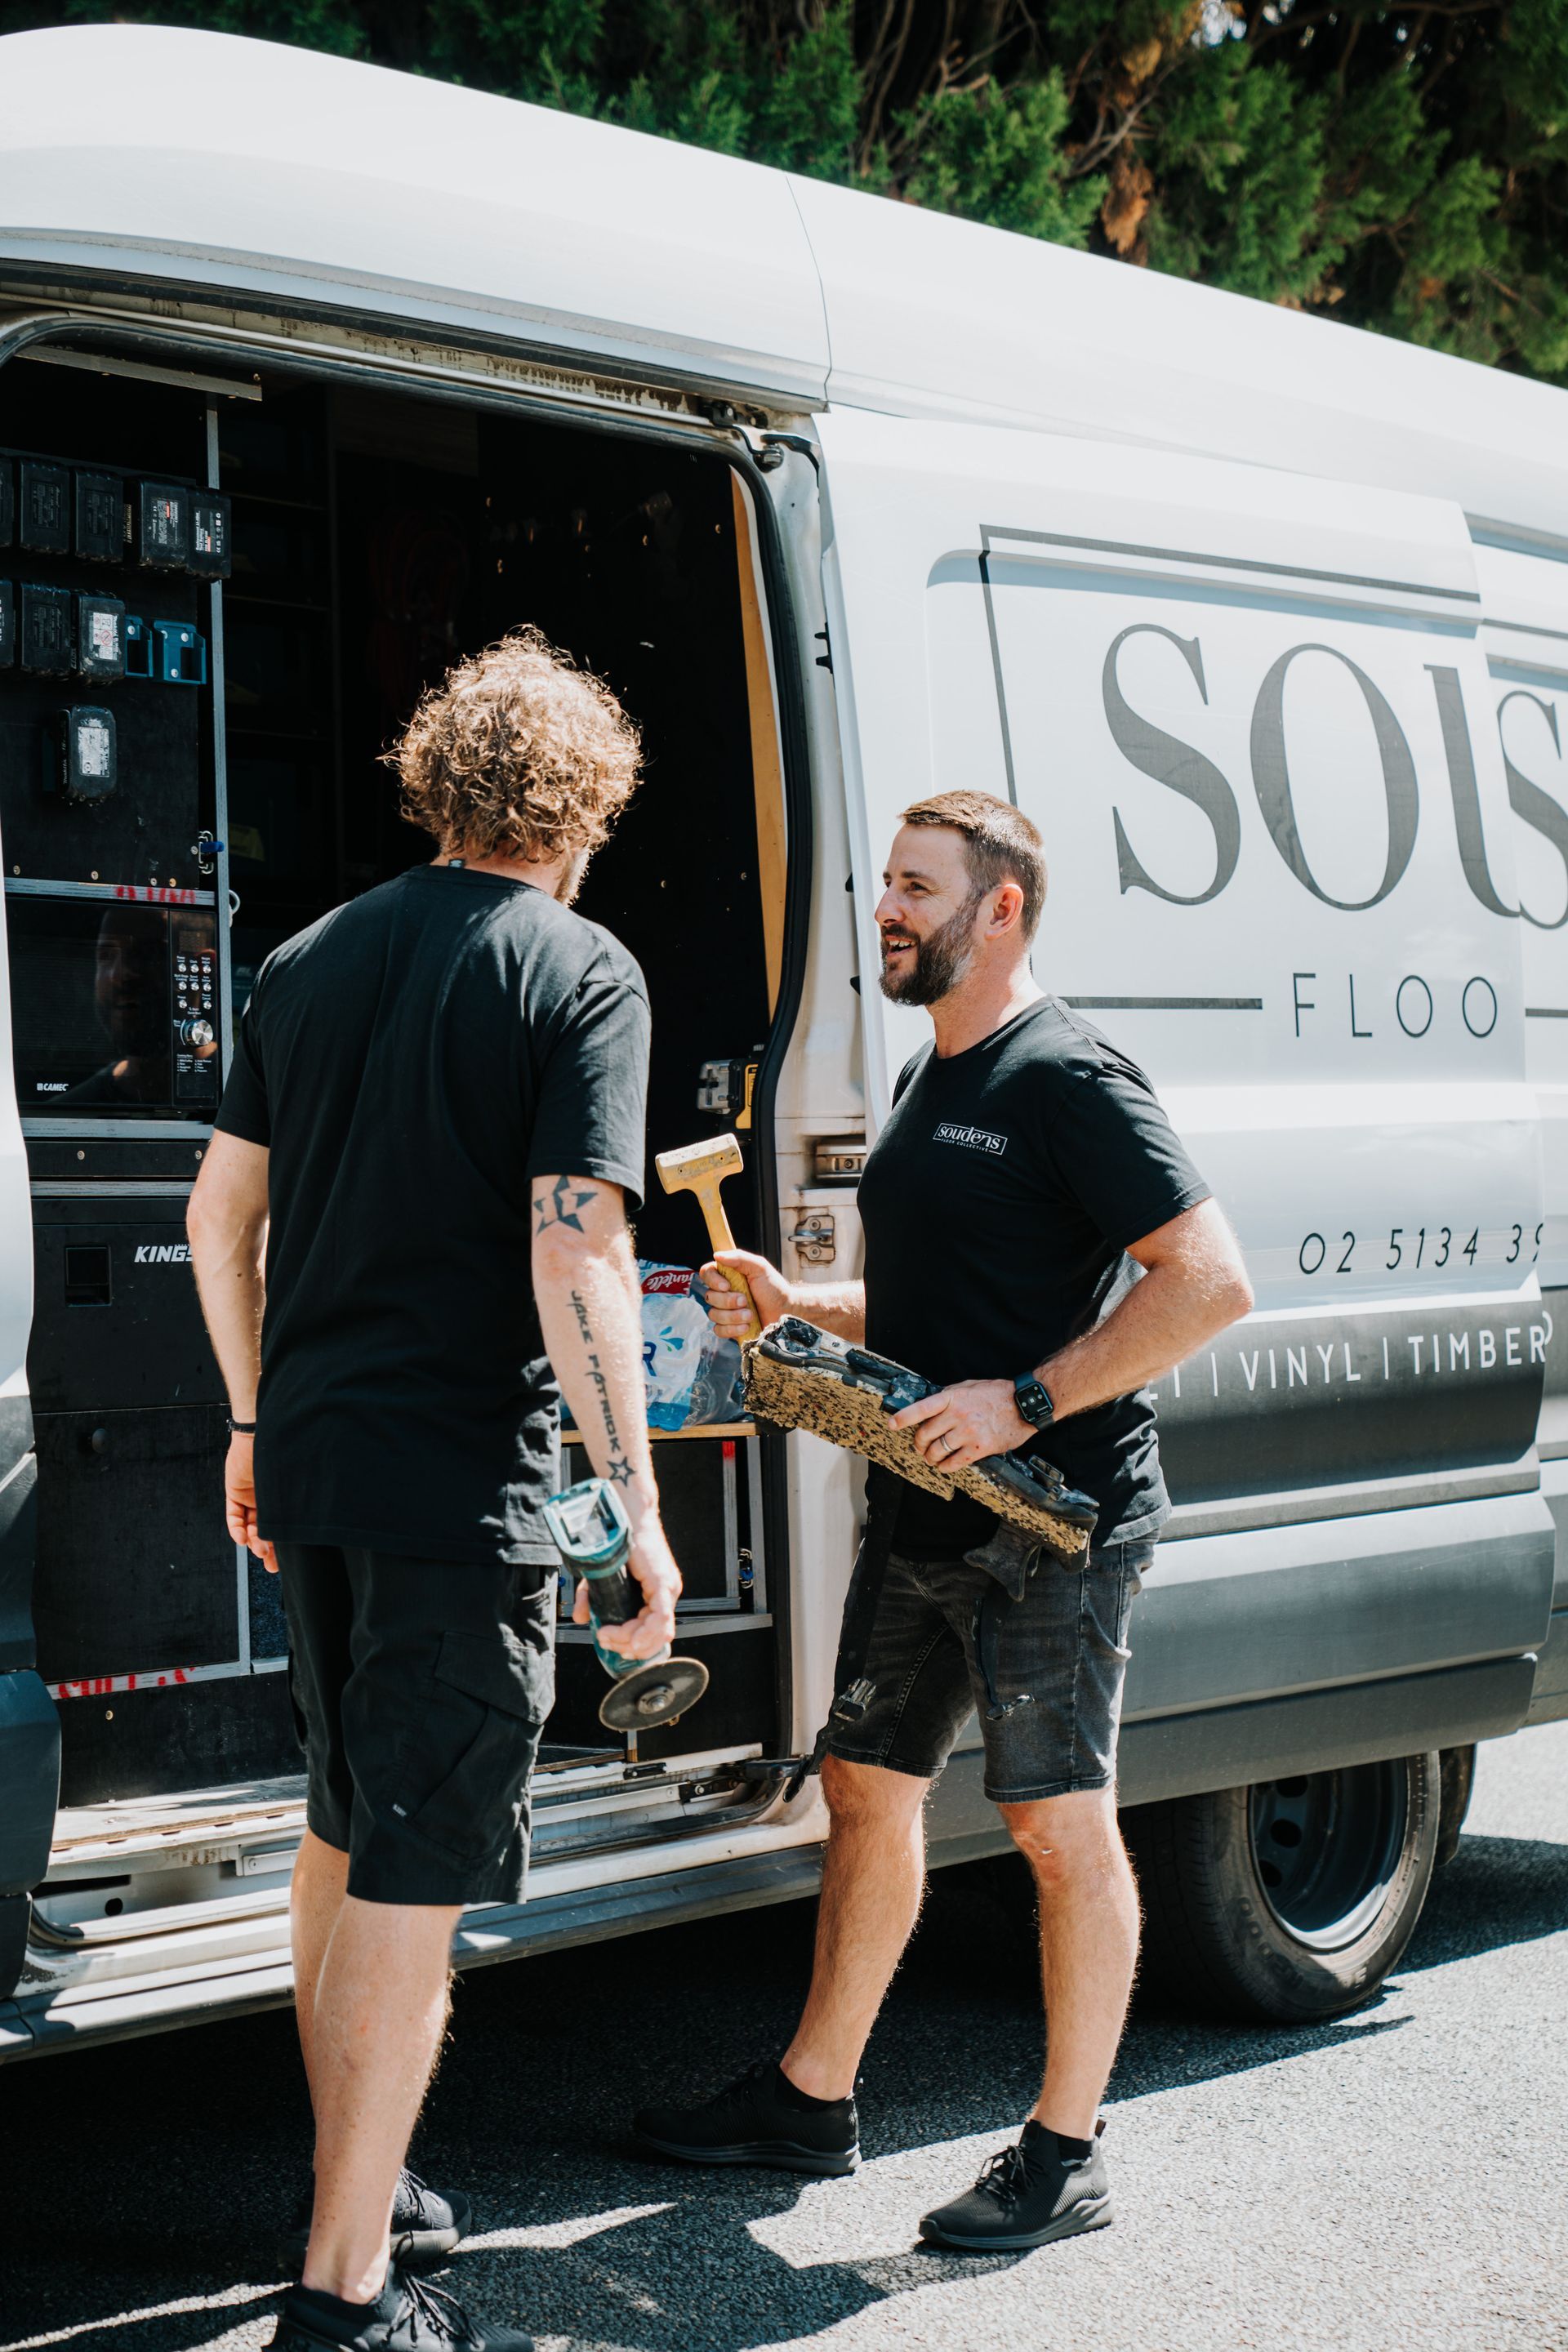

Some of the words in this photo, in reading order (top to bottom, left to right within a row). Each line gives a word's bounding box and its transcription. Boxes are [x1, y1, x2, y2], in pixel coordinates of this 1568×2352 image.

[1292, 972, 1498, 1039] FLOO
[938, 1126, 1000, 1150] soudens
[1386, 1226, 1479, 1270] 5134
[1239, 1343, 1361, 1392] VINYL
[1407, 1325, 1547, 1375] TIMBER
